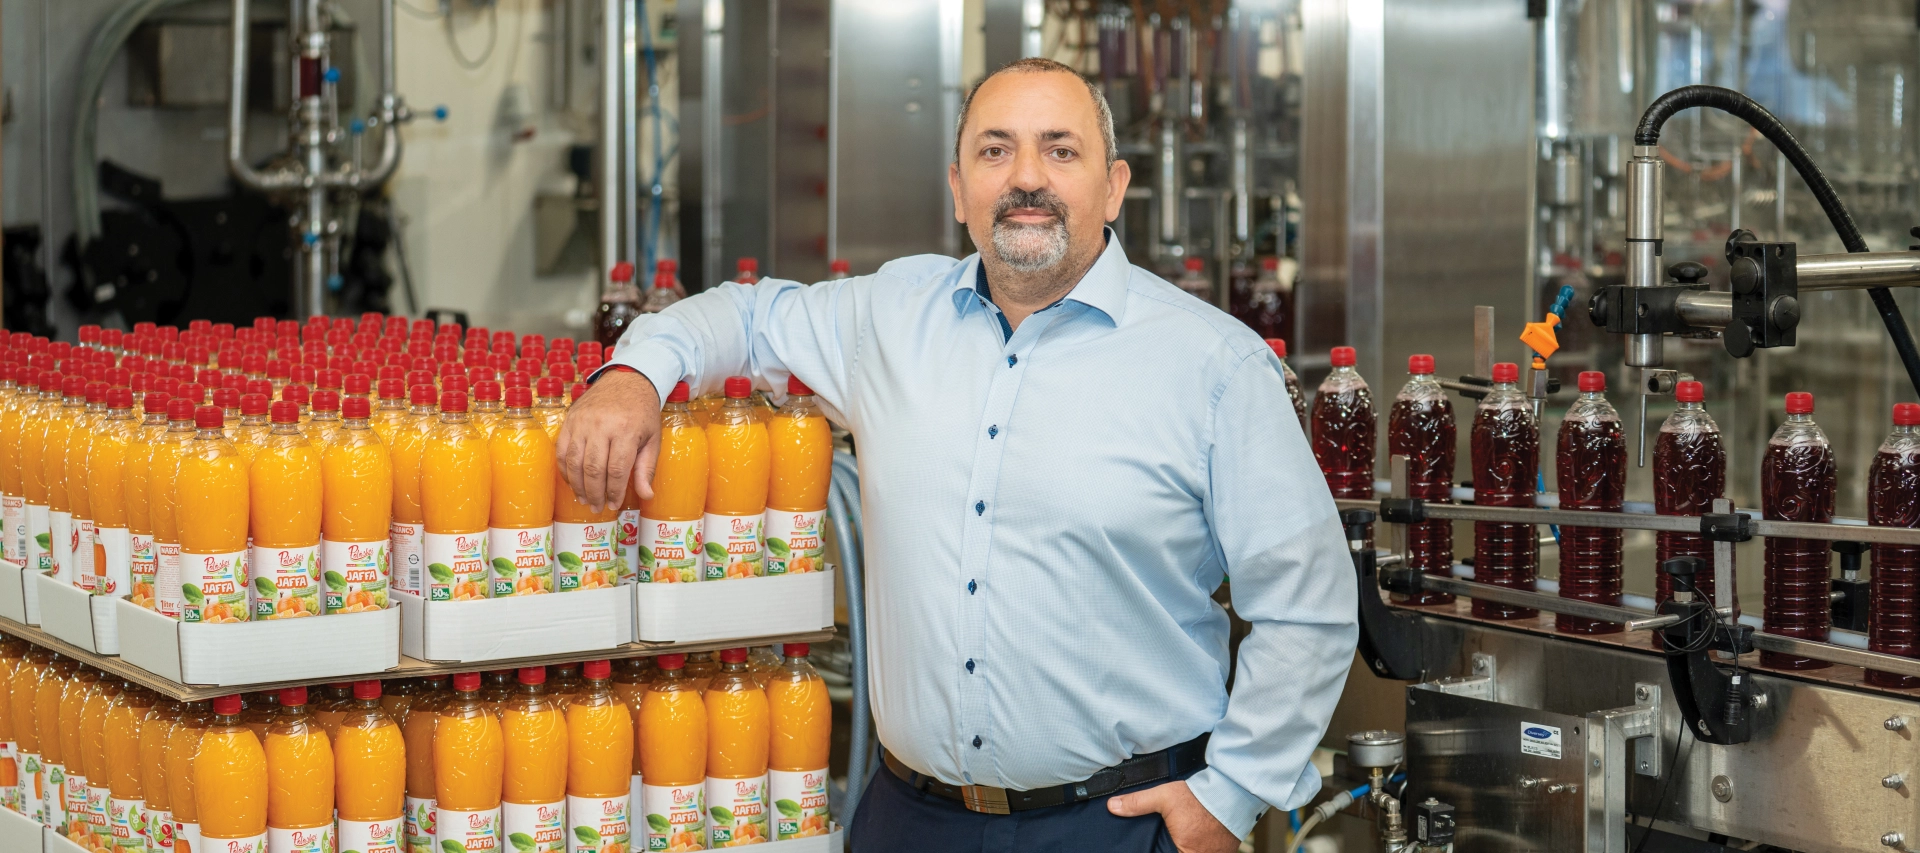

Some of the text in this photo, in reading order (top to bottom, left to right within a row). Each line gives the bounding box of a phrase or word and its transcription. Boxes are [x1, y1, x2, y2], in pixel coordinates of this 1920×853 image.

[82, 522, 92, 530] NA
[728, 542, 756, 553] JAFFA
[790, 538, 818, 549] JAFFA
[582, 550, 609, 561] JAFFA
[655, 548, 683, 558] JAFFA
[454, 560, 481, 572] JAFFA
[517, 556, 544, 567] JAFFA
[769, 562, 784, 571] 50%
[132, 562, 154, 573] JAFFA
[707, 566, 722, 576] 50%
[347, 570, 376, 582] JAFFA
[561, 577, 578, 586] 50%
[277, 576, 306, 588] JAFFA
[496, 582, 512, 592] 50%
[204, 582, 233, 594] JAFFA
[432, 588, 450, 598] 50%
[327, 596, 342, 606] 50%
[258, 603, 272, 612] 50%
[185, 610, 200, 618] 50%
[69, 800, 88, 812] JAFF
[801, 796, 826, 808] JAFFA
[734, 804, 760, 816] JAFFA
[670, 812, 698, 824] JAFFA
[600, 823, 626, 836] JAFFA
[780, 822, 797, 833] 50%
[536, 830, 561, 842] JAFFA
[714, 830, 730, 840] 50%
[466, 838, 494, 849] JAFFA
[650, 837, 666, 848] 50%
